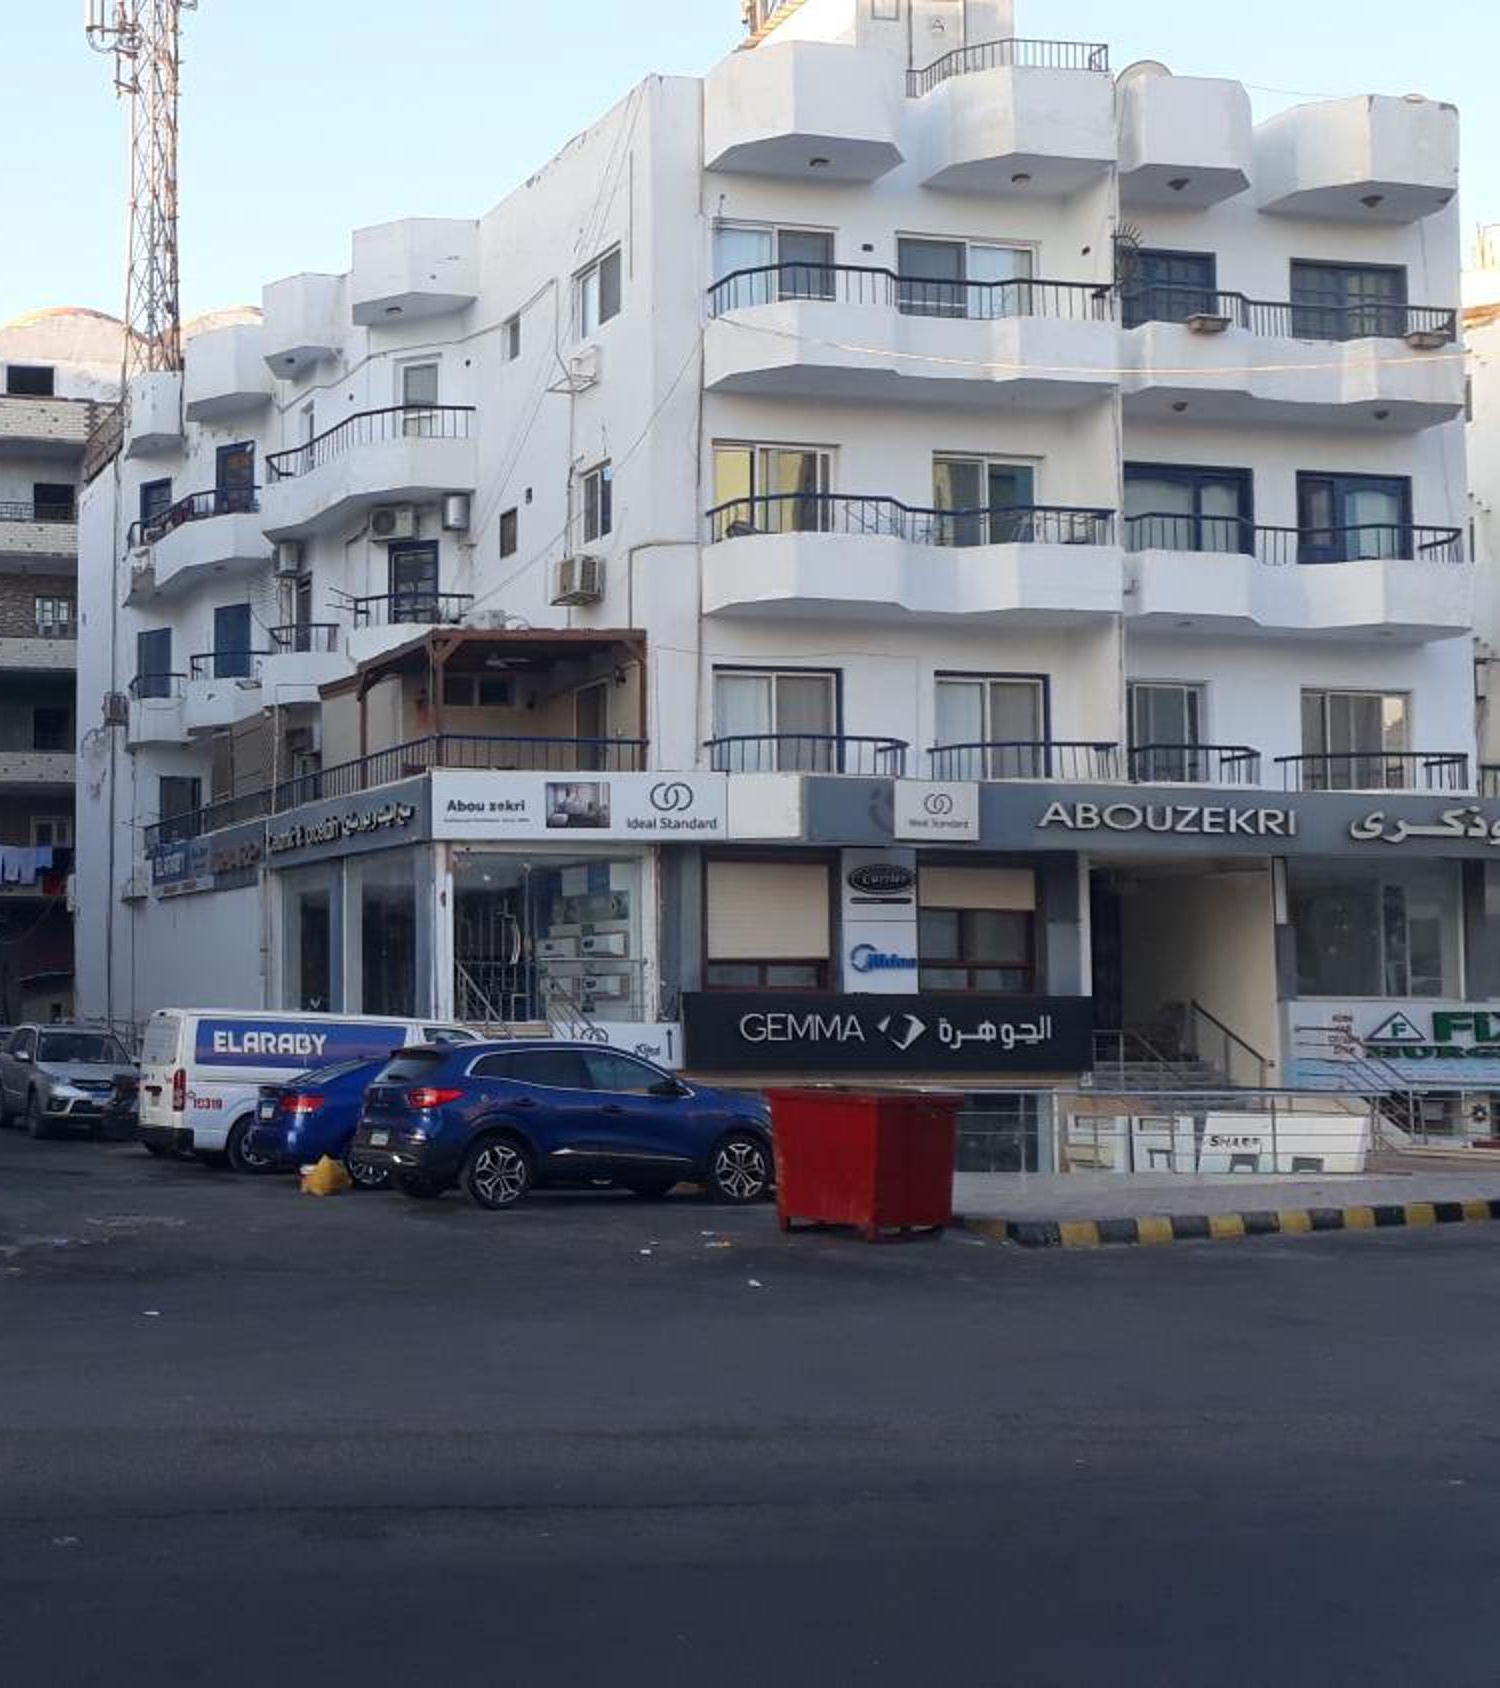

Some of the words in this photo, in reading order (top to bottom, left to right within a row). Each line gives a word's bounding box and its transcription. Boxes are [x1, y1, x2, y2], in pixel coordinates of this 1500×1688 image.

[447, 799, 485, 812] Abou
[489, 799, 525, 812] zekri
[627, 816, 657, 830] Ideal
[659, 816, 718, 831] Standard
[1036, 802, 1297, 836] ABOUZEKRI
[739, 1013, 866, 1042] GEMMA
[938, 1015, 1052, 1049] الجوهرة
[1391, 1022, 1407, 1037] F
[213, 1030, 328, 1056] ELARABY
